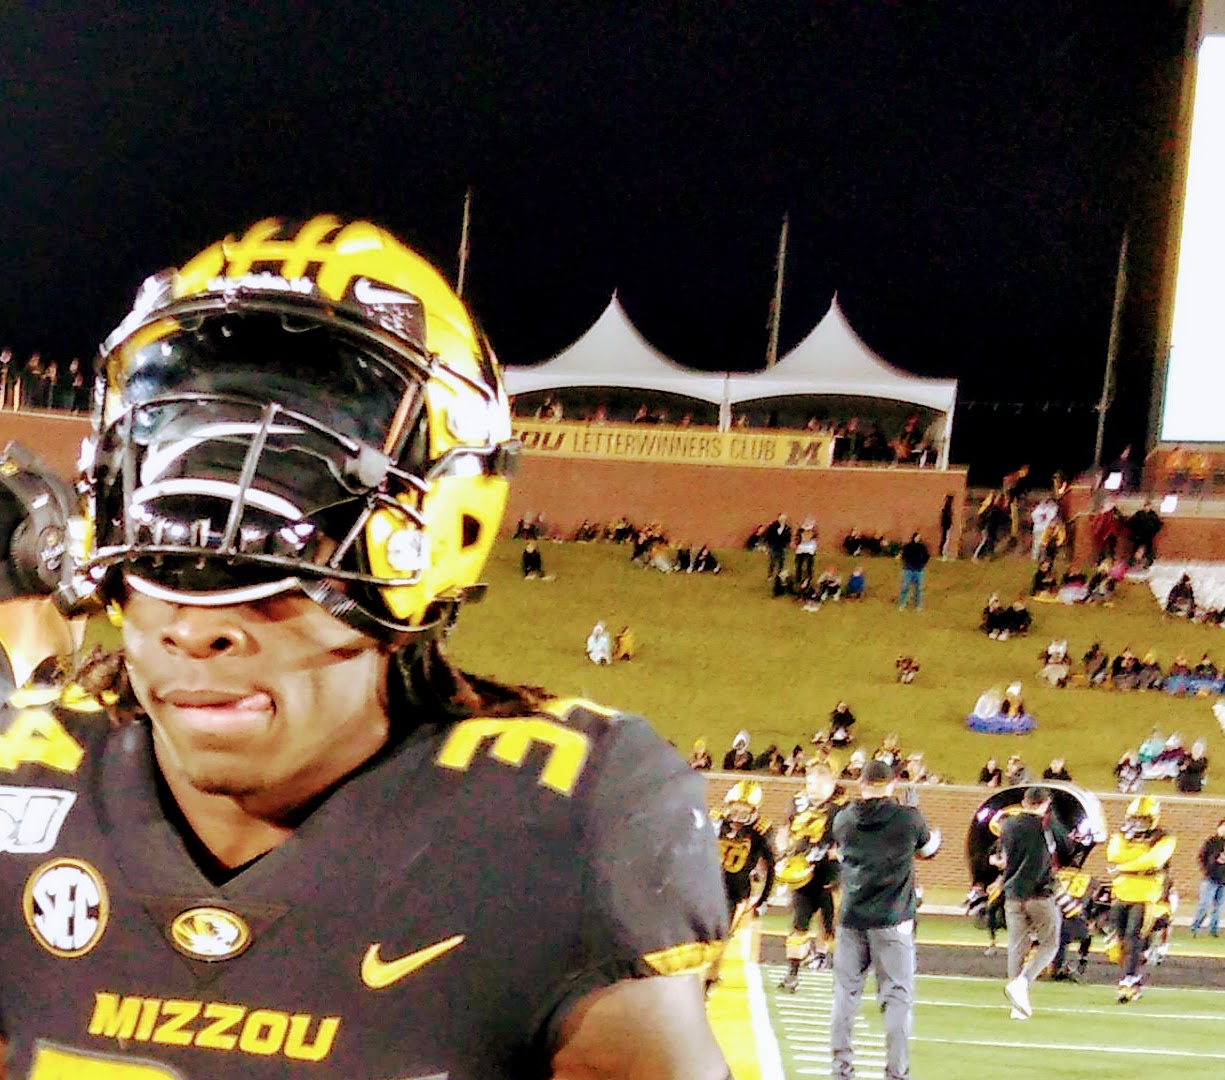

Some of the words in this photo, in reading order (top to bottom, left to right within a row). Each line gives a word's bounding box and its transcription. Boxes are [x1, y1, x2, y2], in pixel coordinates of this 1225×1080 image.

[572, 431, 722, 459] LETTERWINNERS
[729, 437, 776, 461] CLUB
[784, 439, 823, 467] M
[88, 991, 342, 1062] MIZZOU
